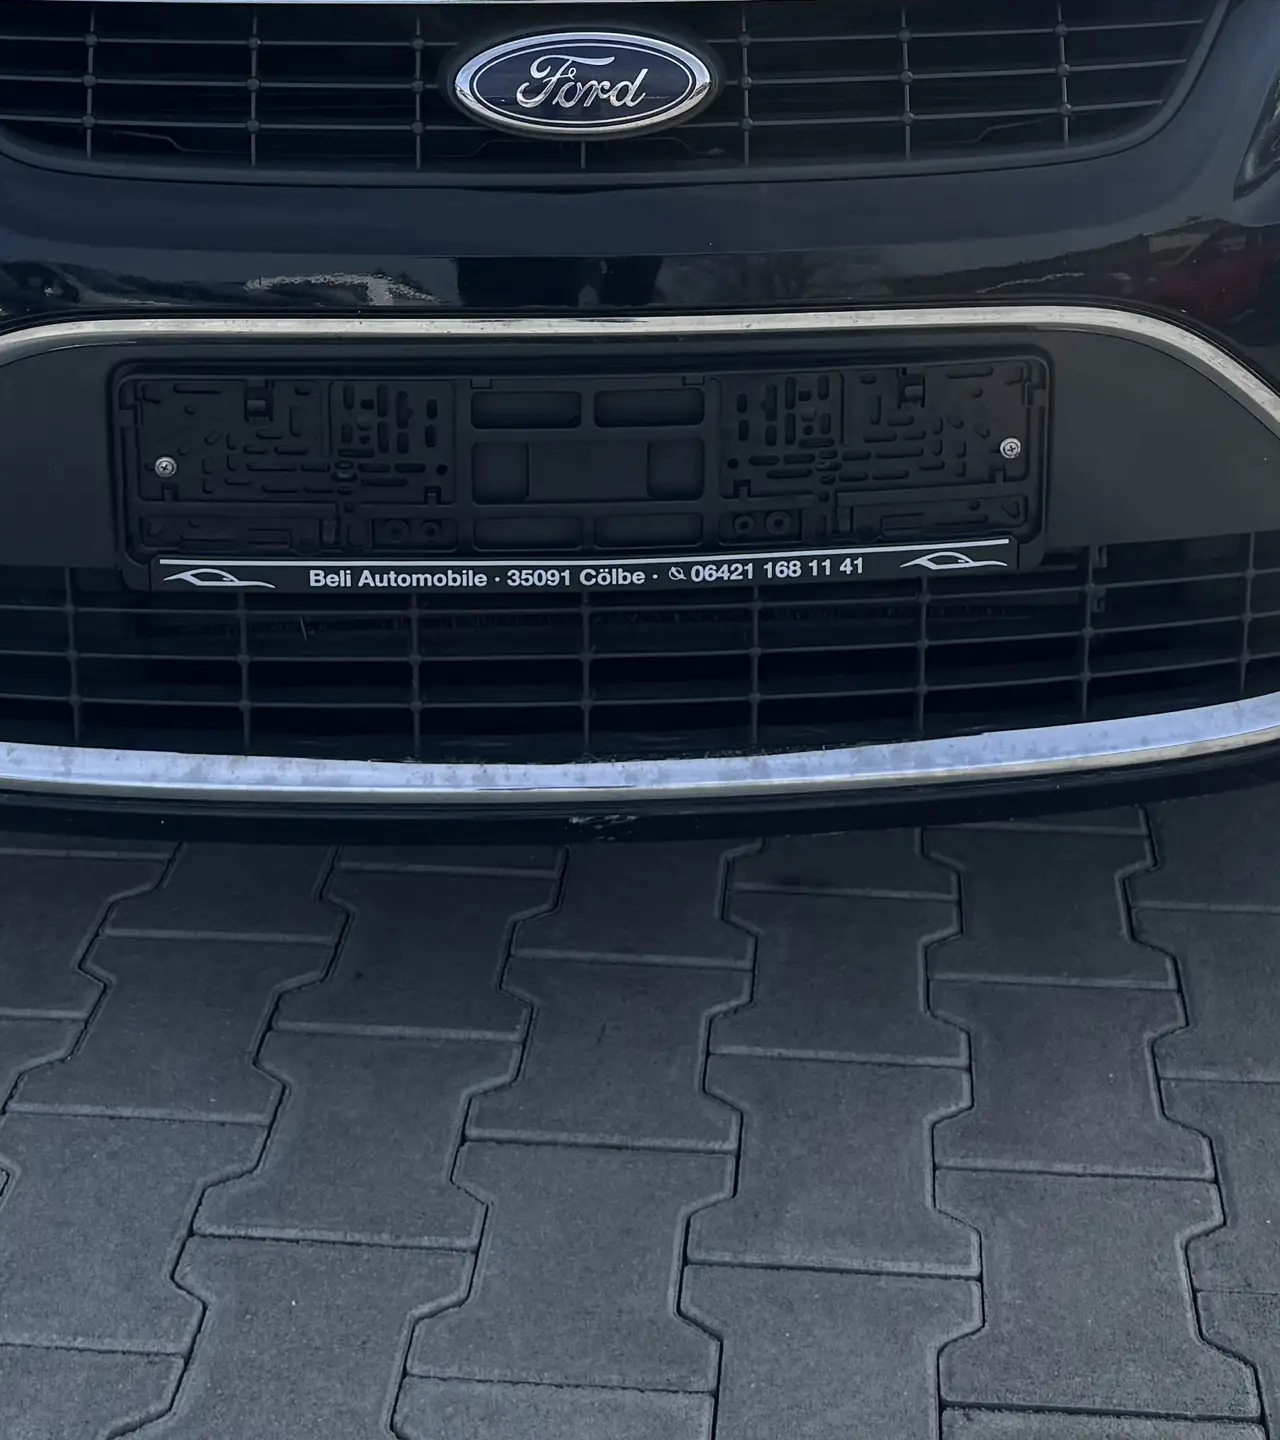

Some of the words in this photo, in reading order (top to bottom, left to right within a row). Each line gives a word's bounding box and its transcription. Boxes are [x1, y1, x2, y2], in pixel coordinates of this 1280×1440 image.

[516, 54, 649, 108] Ford
[308, 569, 352, 587] Beli
[357, 569, 488, 587] Automobile
[506, 569, 571, 587] 35091
[579, 568, 646, 586] Cölbe
[690, 562, 754, 582] 06421
[764, 560, 801, 578] 168
[809, 559, 831, 576] 11
[839, 557, 863, 575] 41
